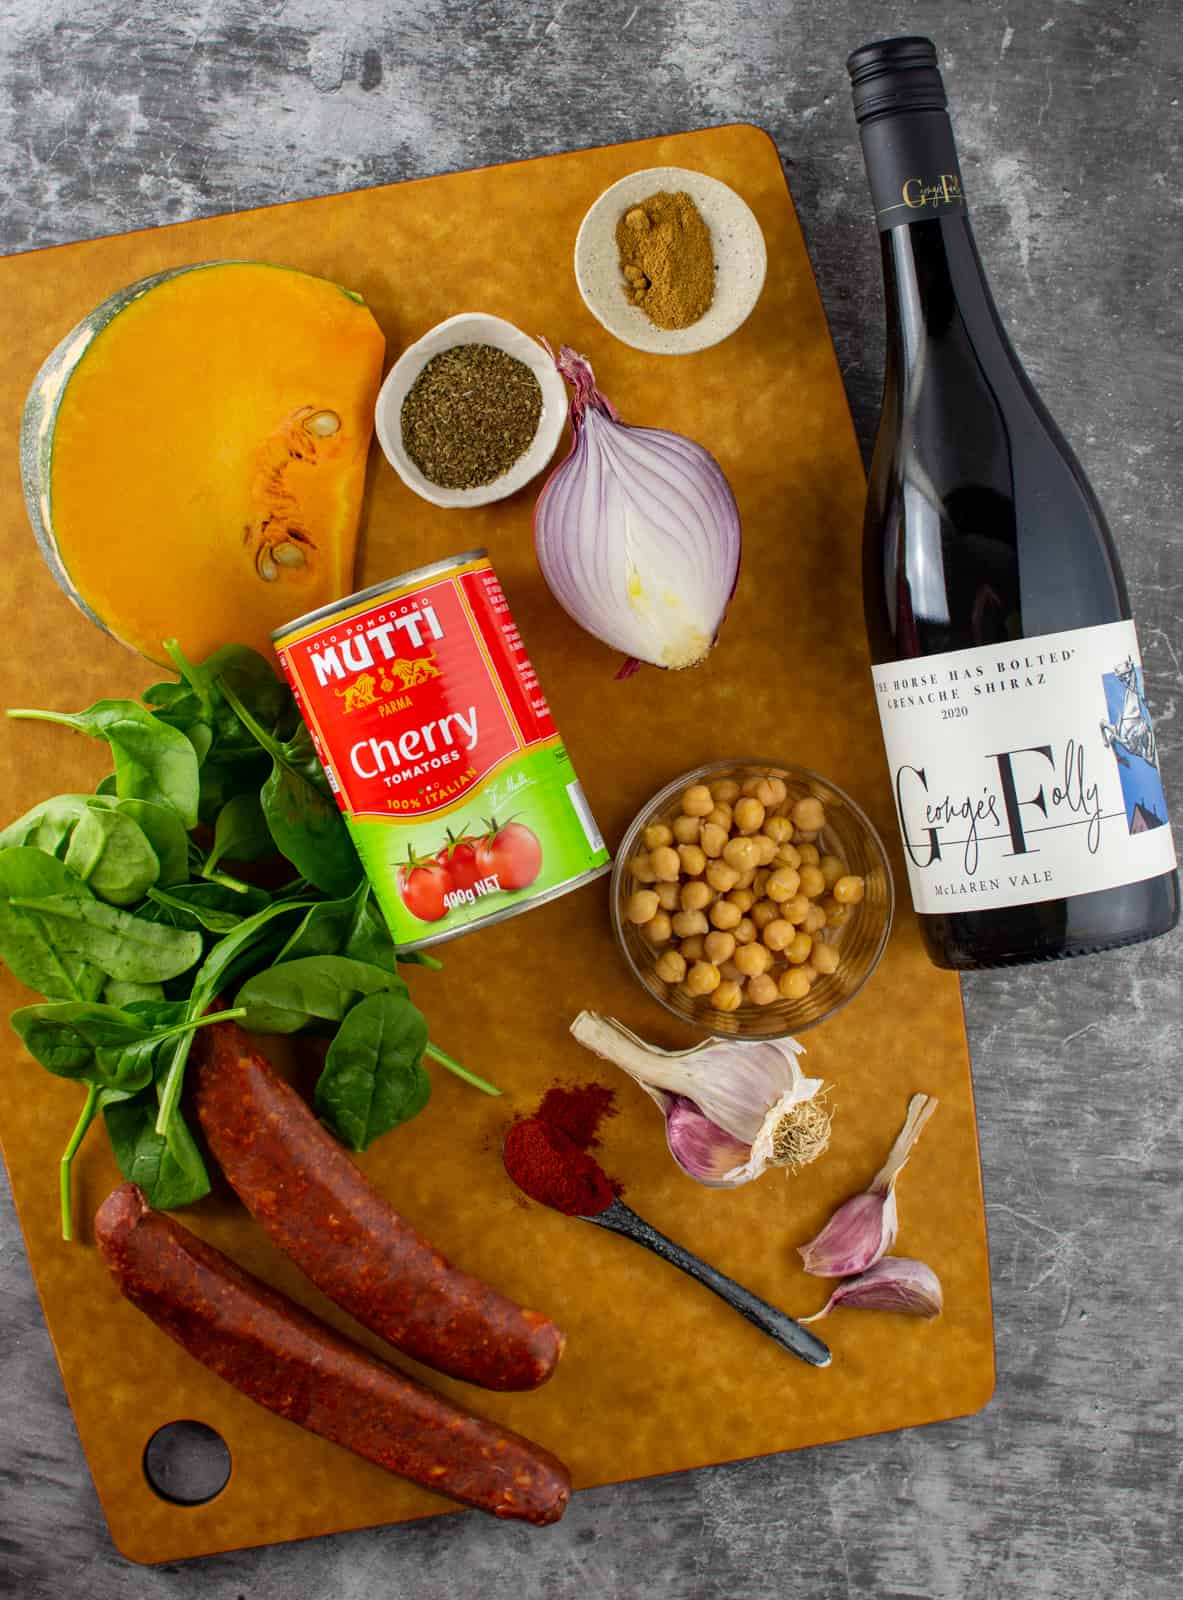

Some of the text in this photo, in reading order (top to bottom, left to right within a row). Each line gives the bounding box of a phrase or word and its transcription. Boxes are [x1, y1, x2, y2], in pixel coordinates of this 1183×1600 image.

[306, 598, 429, 653] SOLO POMODORO
[310, 605, 445, 687] MUTTI
[887, 672, 1047, 710] GRENACHE SHIRAZ
[893, 673, 938, 691] HORSE
[948, 664, 985, 682] HAS
[377, 695, 414, 718] PARMA
[941, 705, 969, 720] 2020
[350, 705, 479, 778] Cherry
[383, 749, 461, 788] TOMATOES
[387, 796, 421, 810] 100%
[425, 767, 478, 805] ITALIAN
[984, 738, 1104, 857] Folly
[443, 873, 501, 910] 400g NET
[935, 869, 1054, 897] McLAREN VALE
